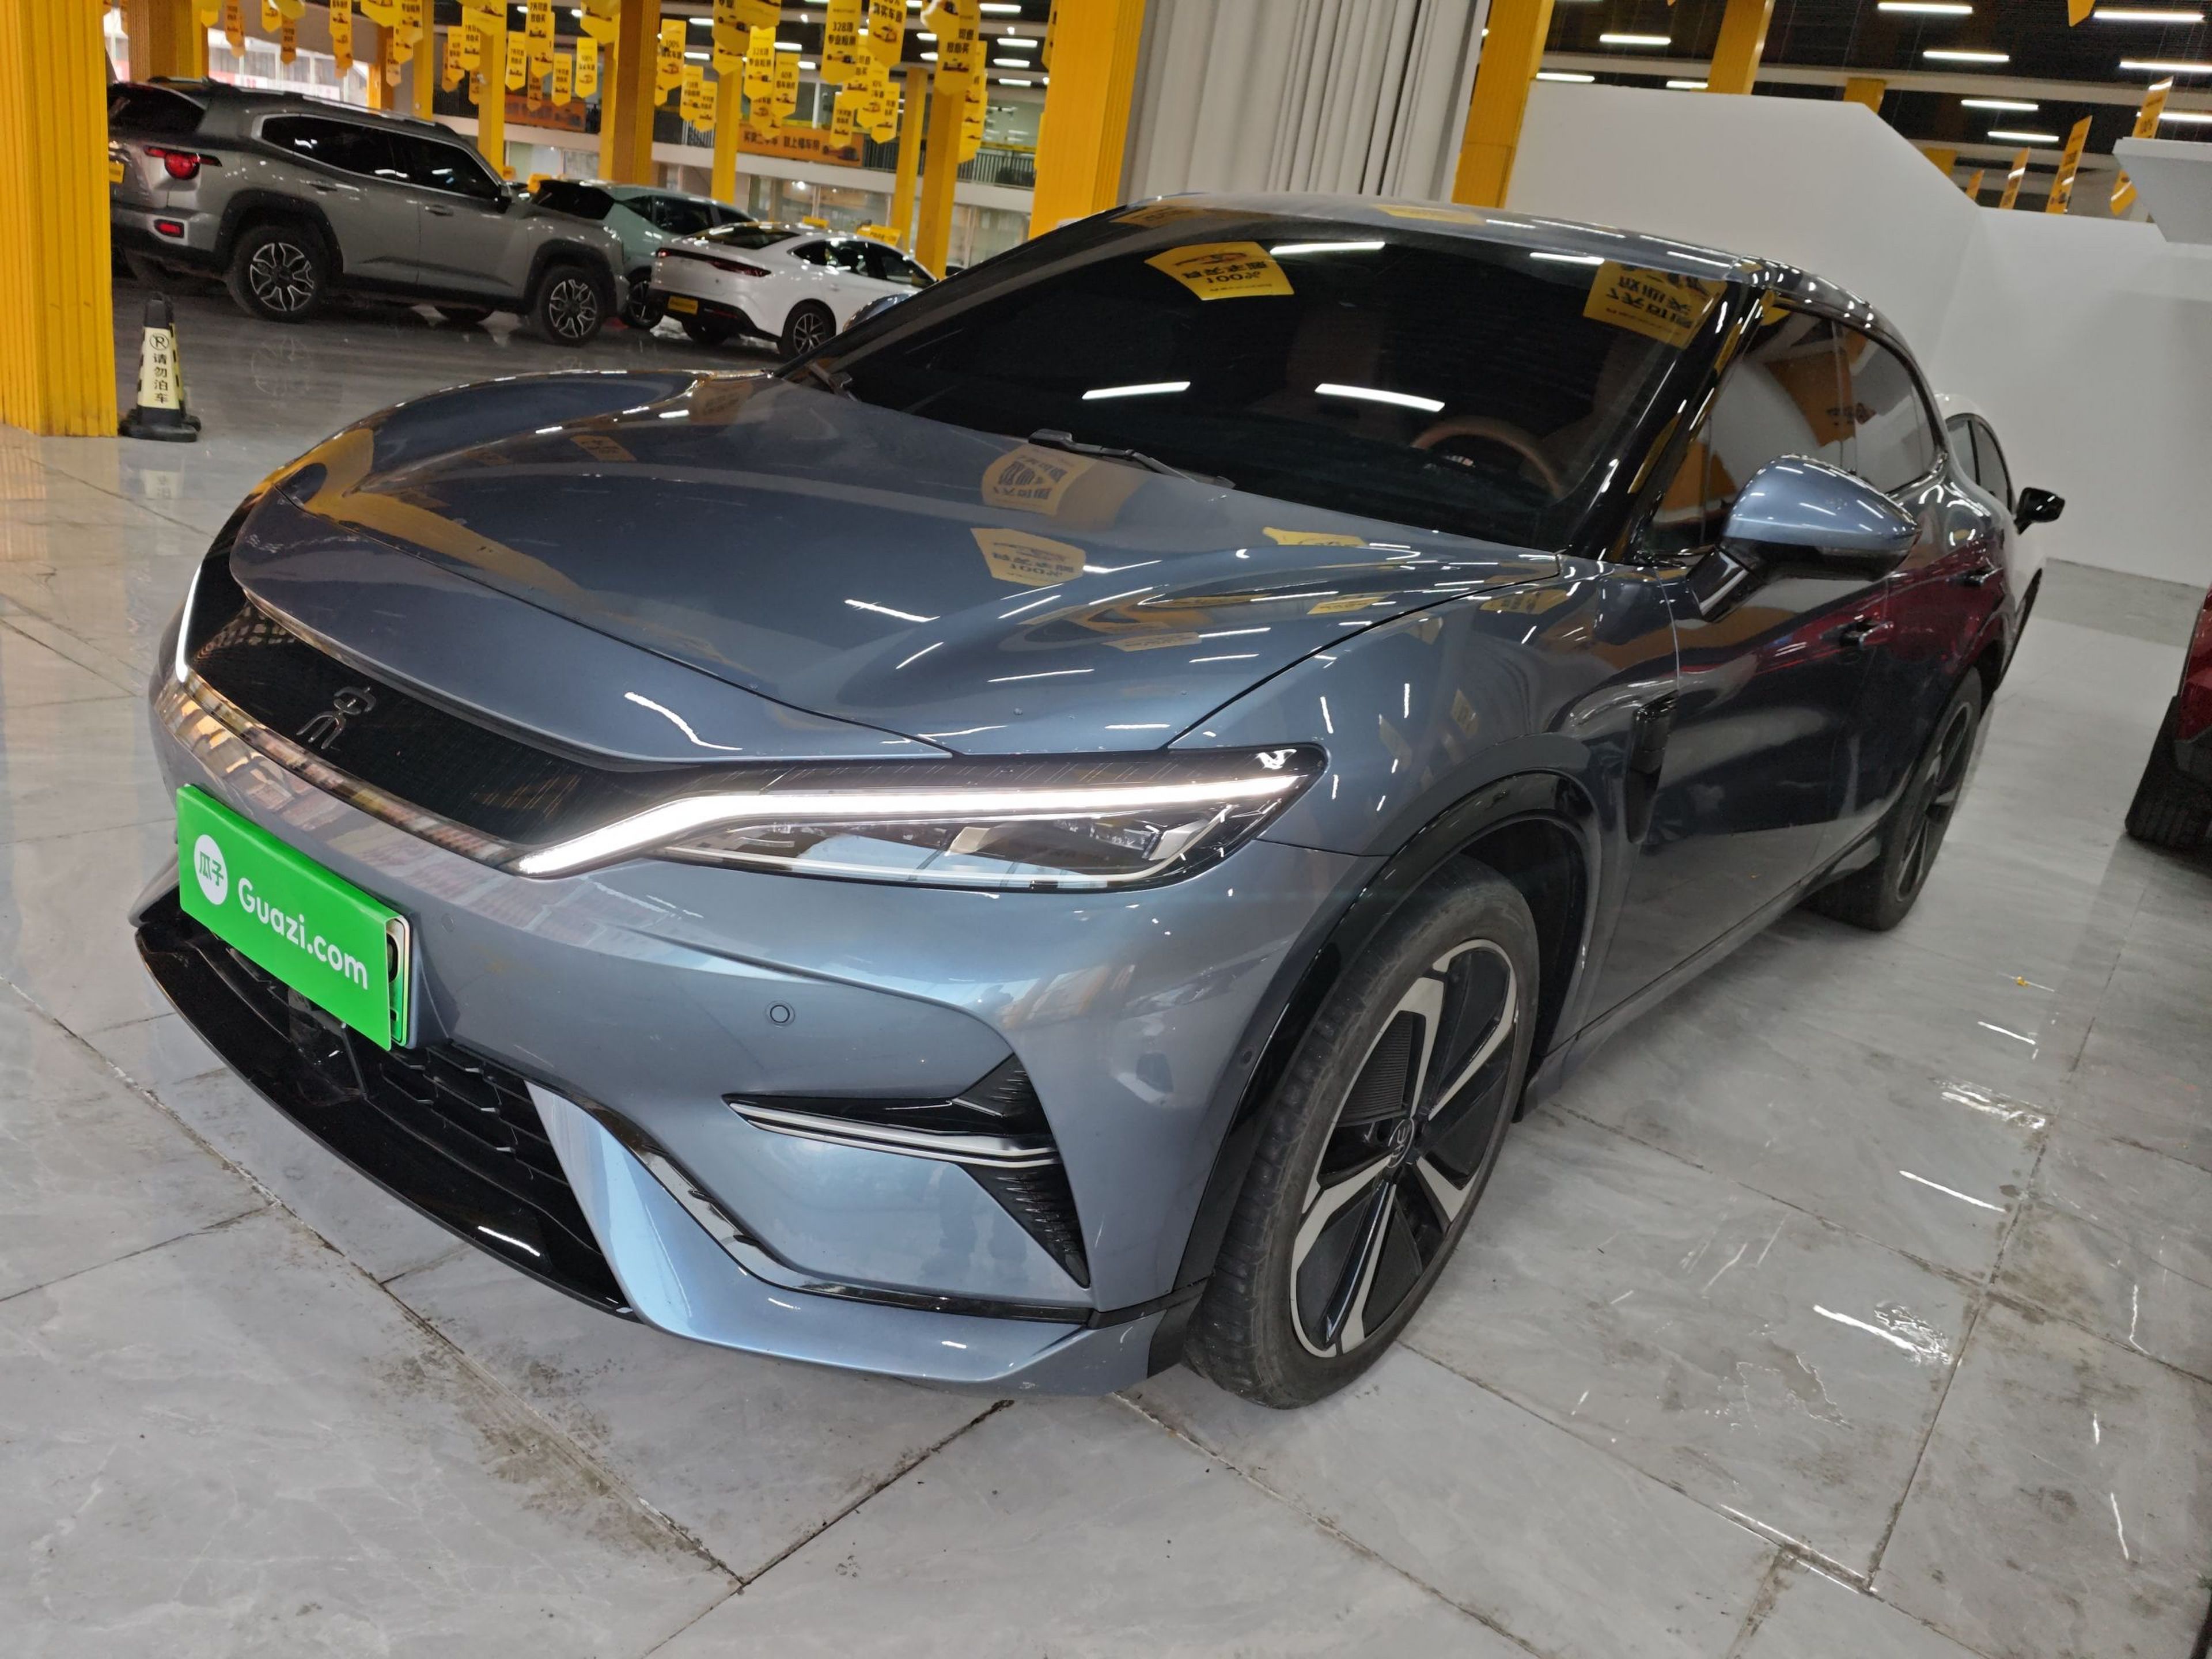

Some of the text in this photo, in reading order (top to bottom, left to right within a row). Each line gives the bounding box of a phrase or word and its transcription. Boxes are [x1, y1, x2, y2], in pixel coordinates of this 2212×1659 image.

[153, 353, 168, 404] 请勿泊车
[198, 850, 225, 887] 瓜子
[237, 877, 369, 990] Guazi.com
